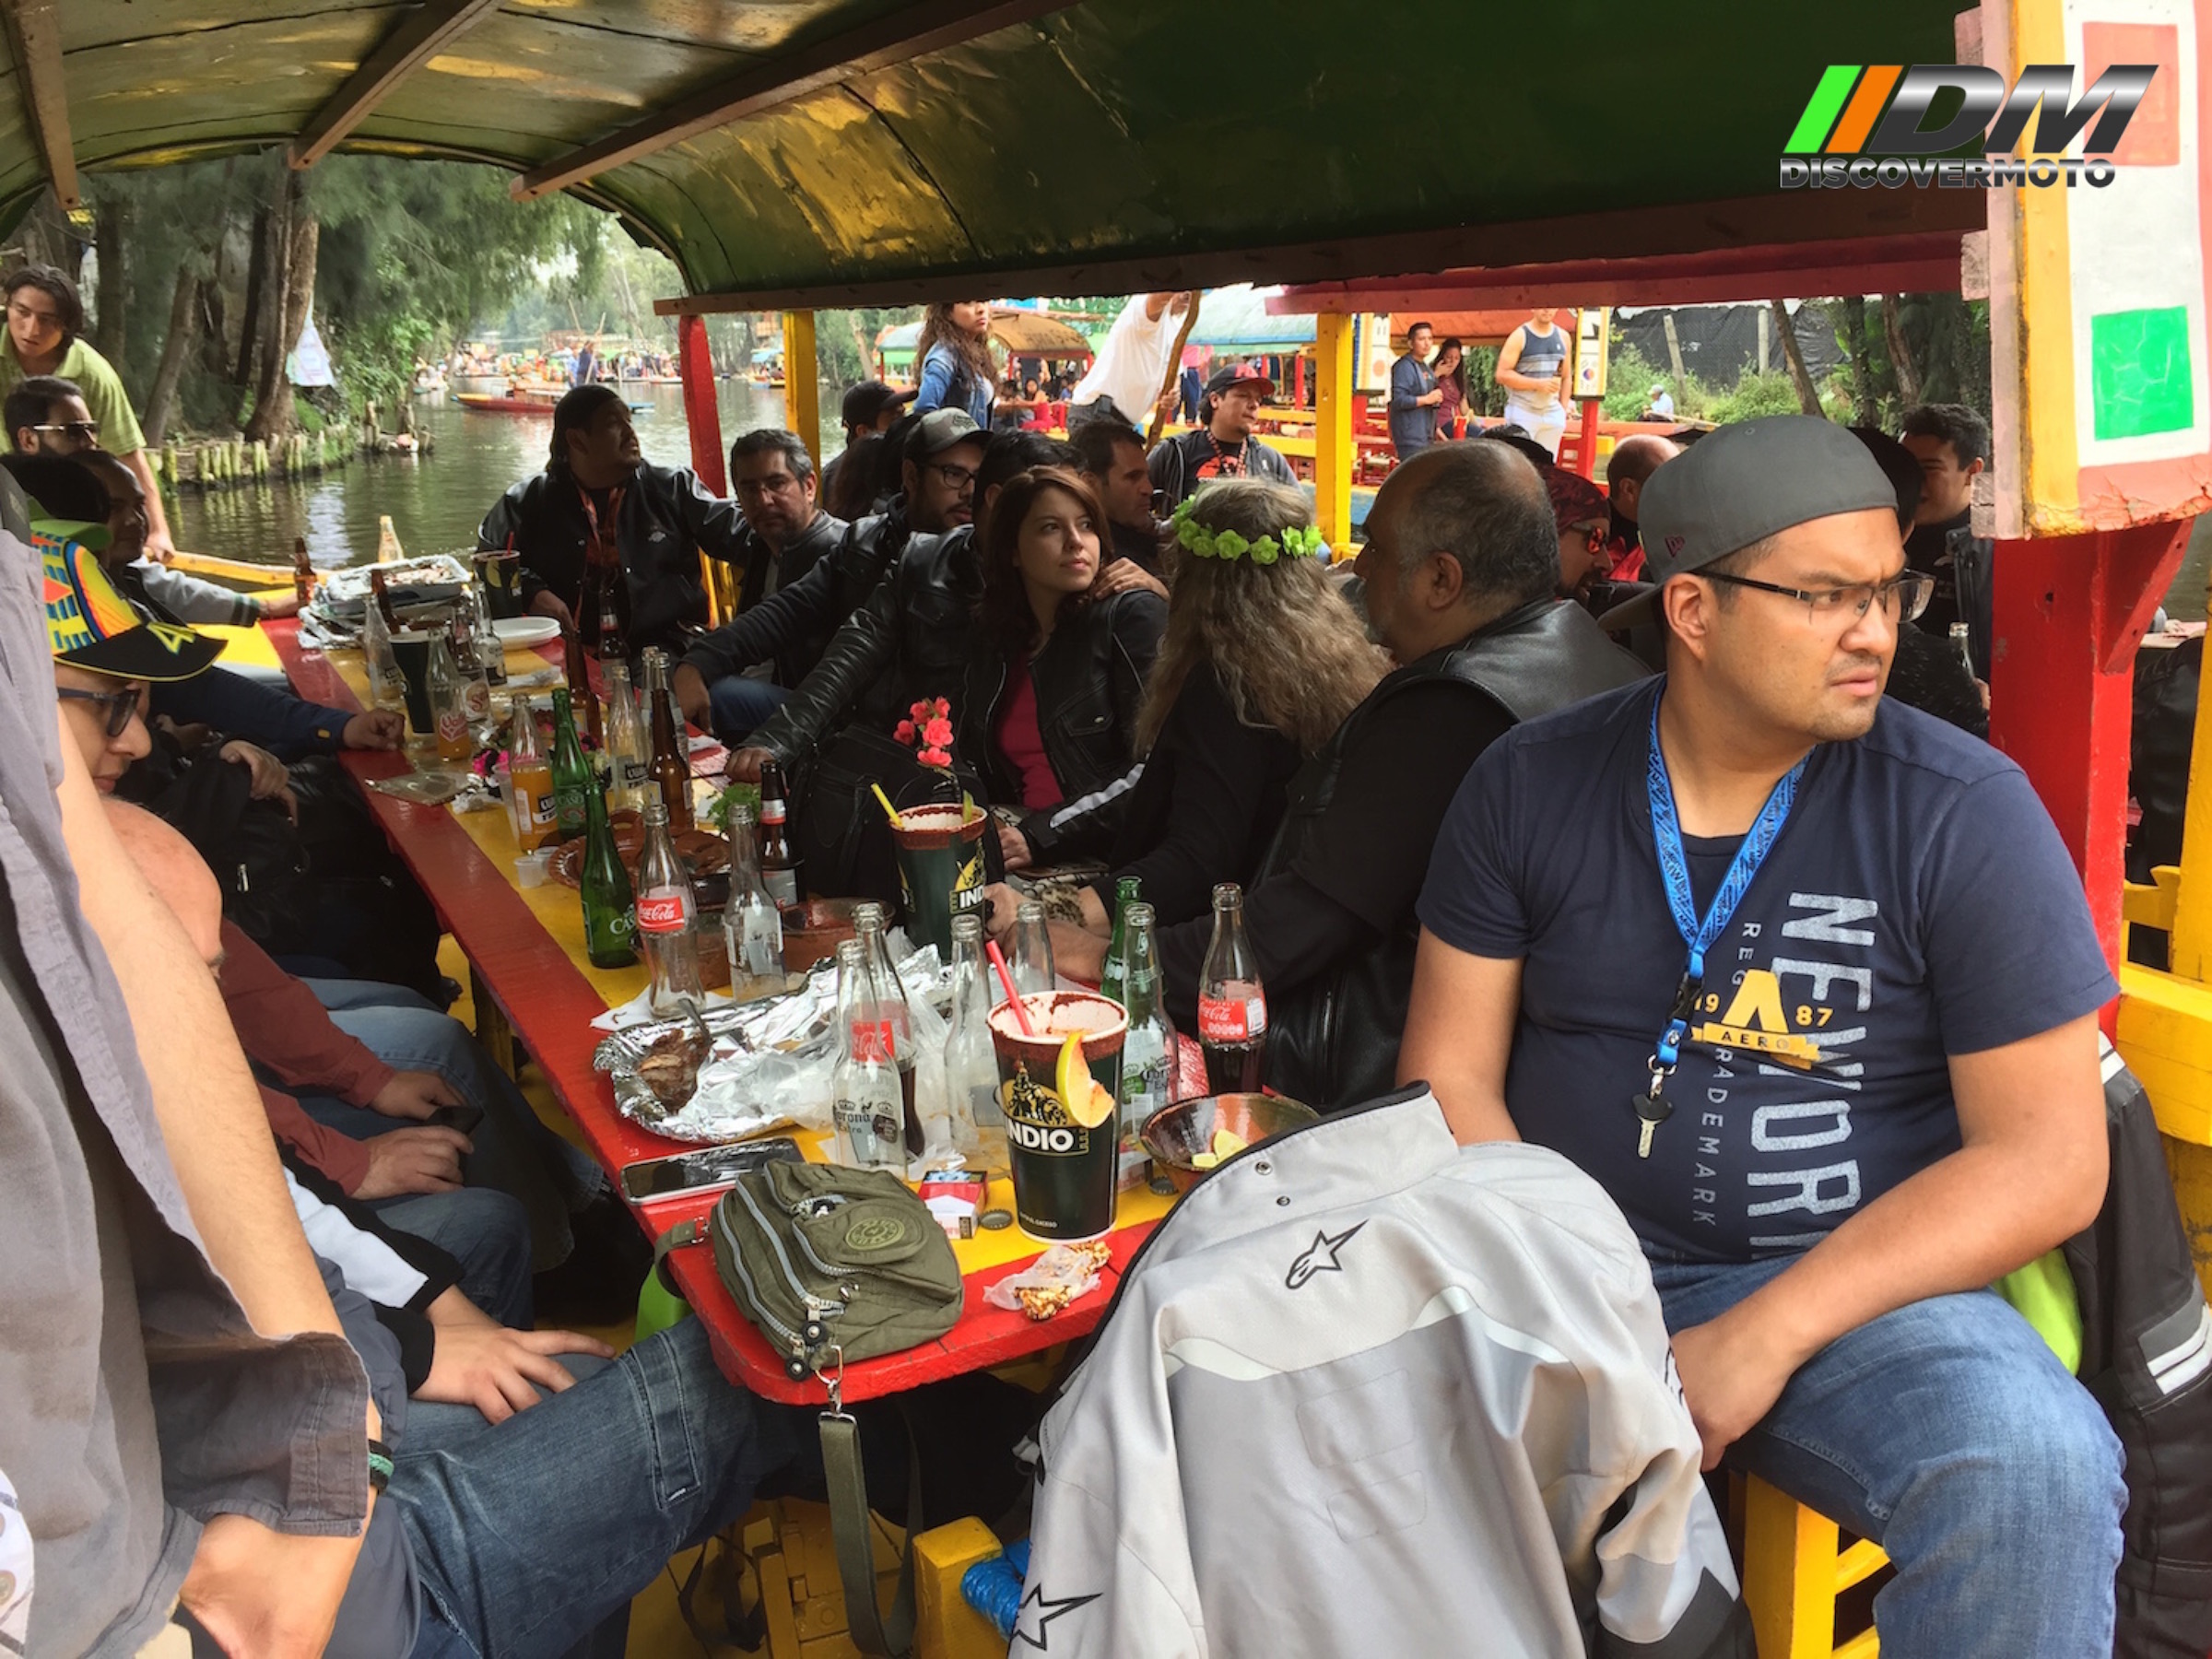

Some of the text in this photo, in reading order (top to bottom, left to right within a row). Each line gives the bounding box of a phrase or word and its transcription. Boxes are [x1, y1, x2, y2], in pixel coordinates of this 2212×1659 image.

[959, 885, 984, 910] IND
[1795, 1005, 1833, 1027] 87
[1721, 1030, 1790, 1051] AERO
[1692, 1048, 1735, 1226] RADEMARK
